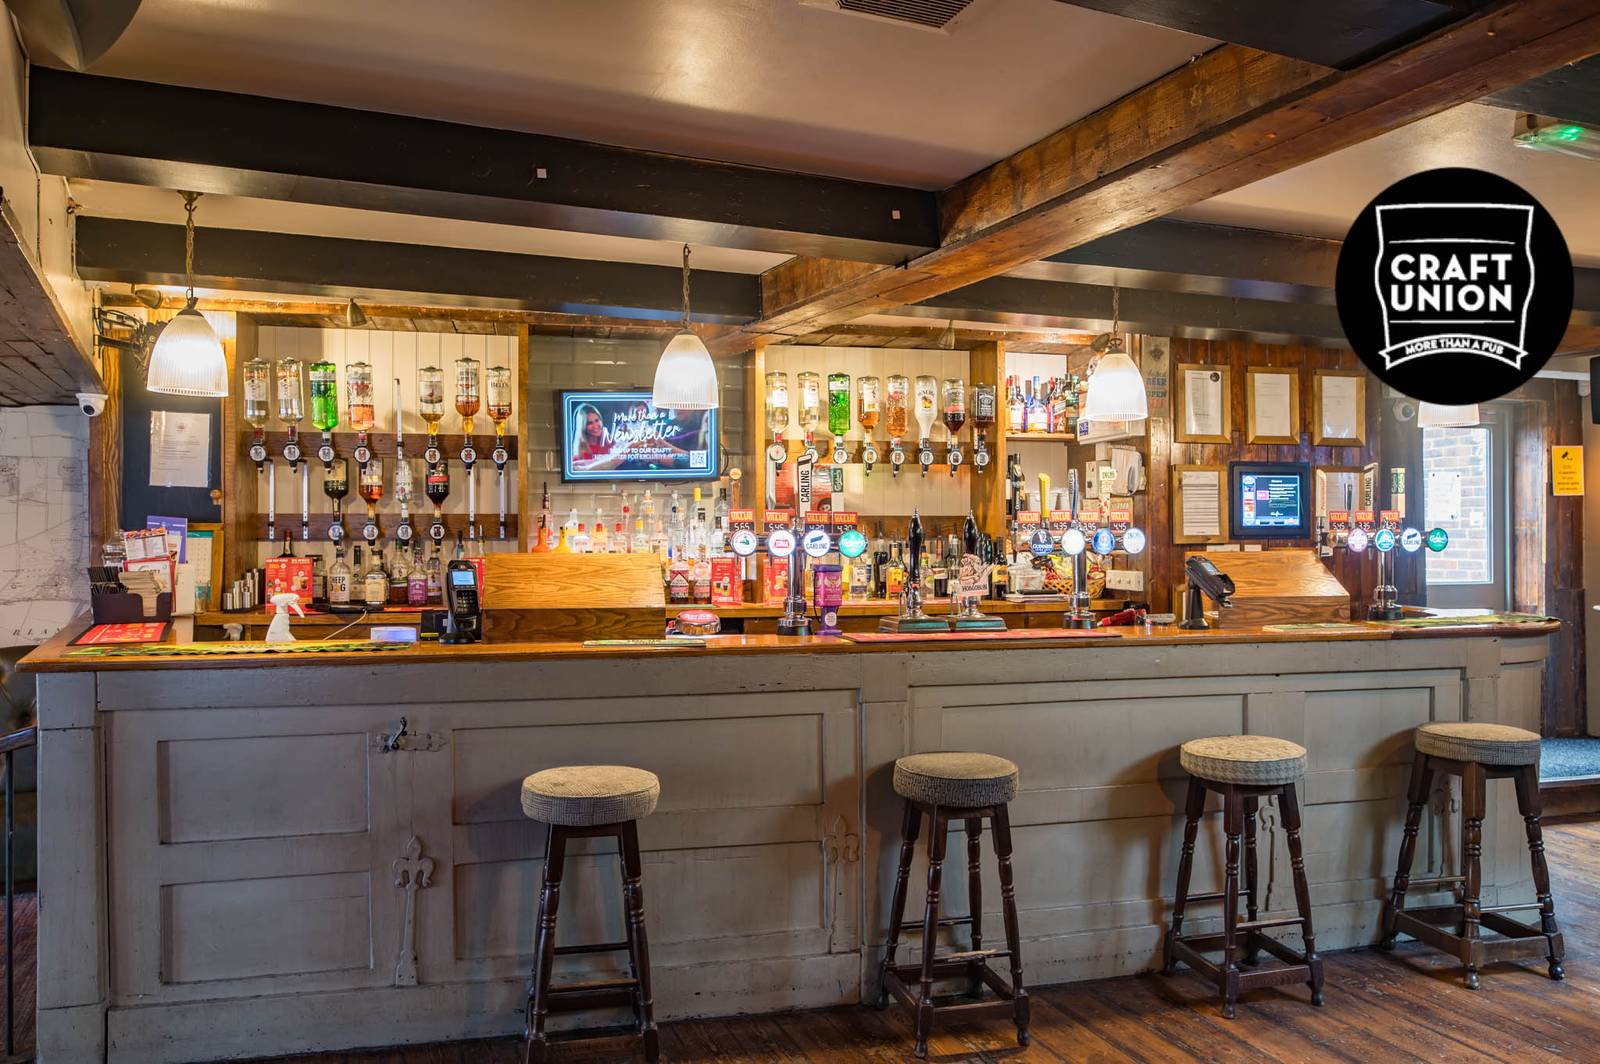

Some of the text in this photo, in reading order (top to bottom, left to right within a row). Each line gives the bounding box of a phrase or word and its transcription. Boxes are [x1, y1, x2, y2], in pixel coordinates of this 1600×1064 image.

[601, 420, 683, 448] Newsletter
[800, 470, 810, 503] CARLING
[1364, 476, 1373, 507] CARLING
